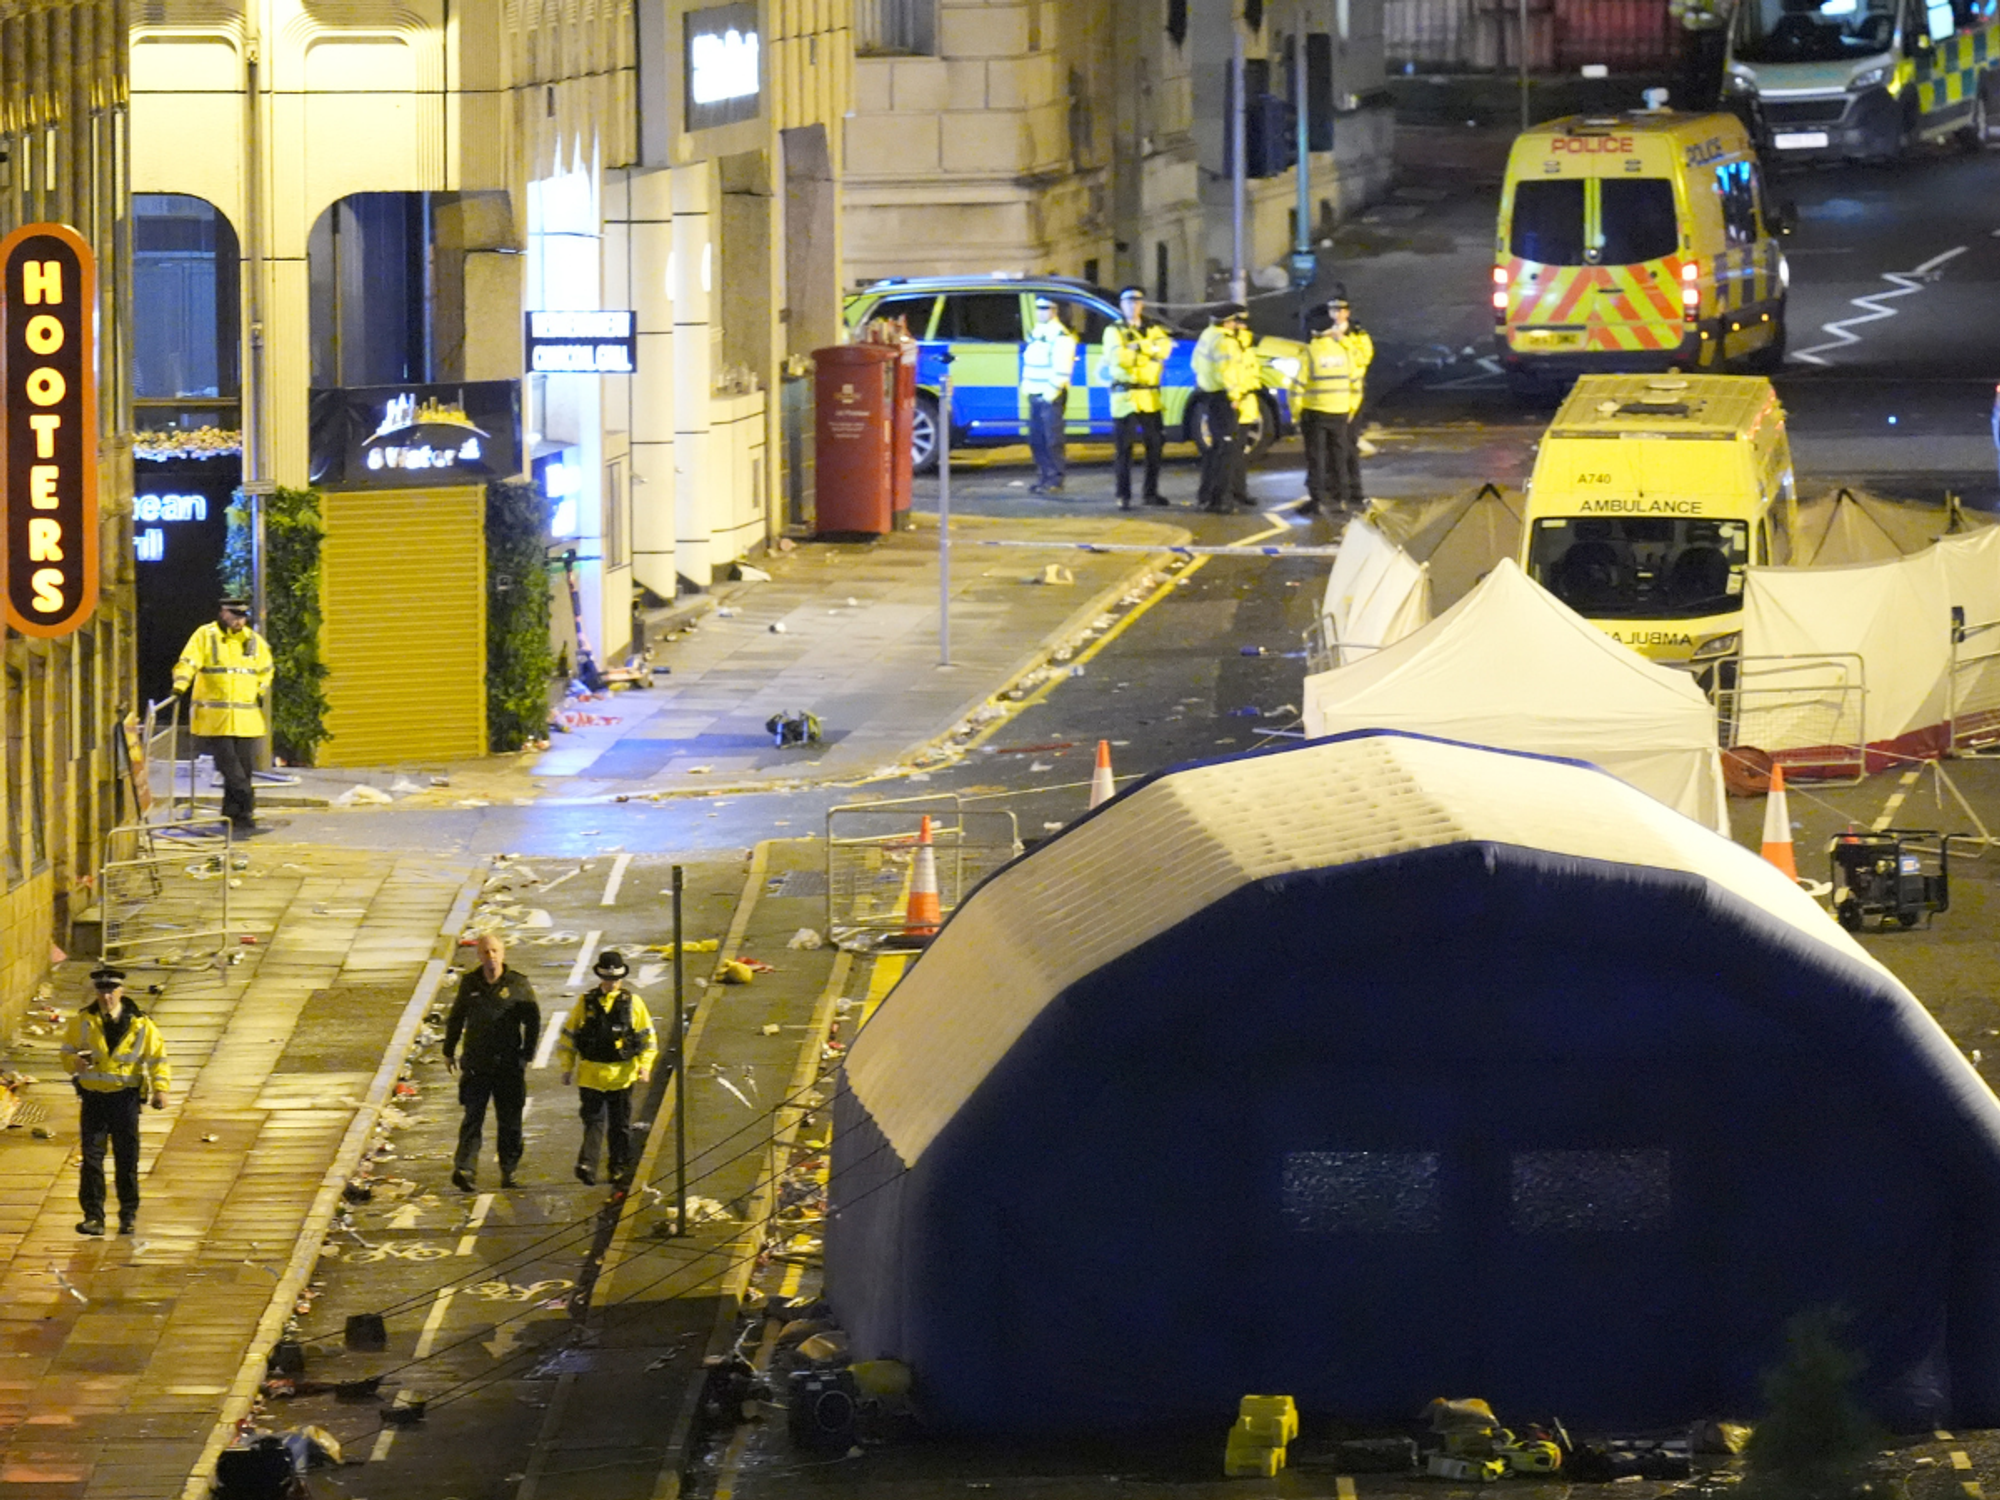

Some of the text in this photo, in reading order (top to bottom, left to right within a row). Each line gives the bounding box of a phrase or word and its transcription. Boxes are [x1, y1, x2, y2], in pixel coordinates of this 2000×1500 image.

[1551, 137, 1633, 153] POLICE
[22, 260, 67, 613] HOOTERS
[1577, 473, 1611, 484] A740
[1580, 500, 1703, 514] AMBULANCE
